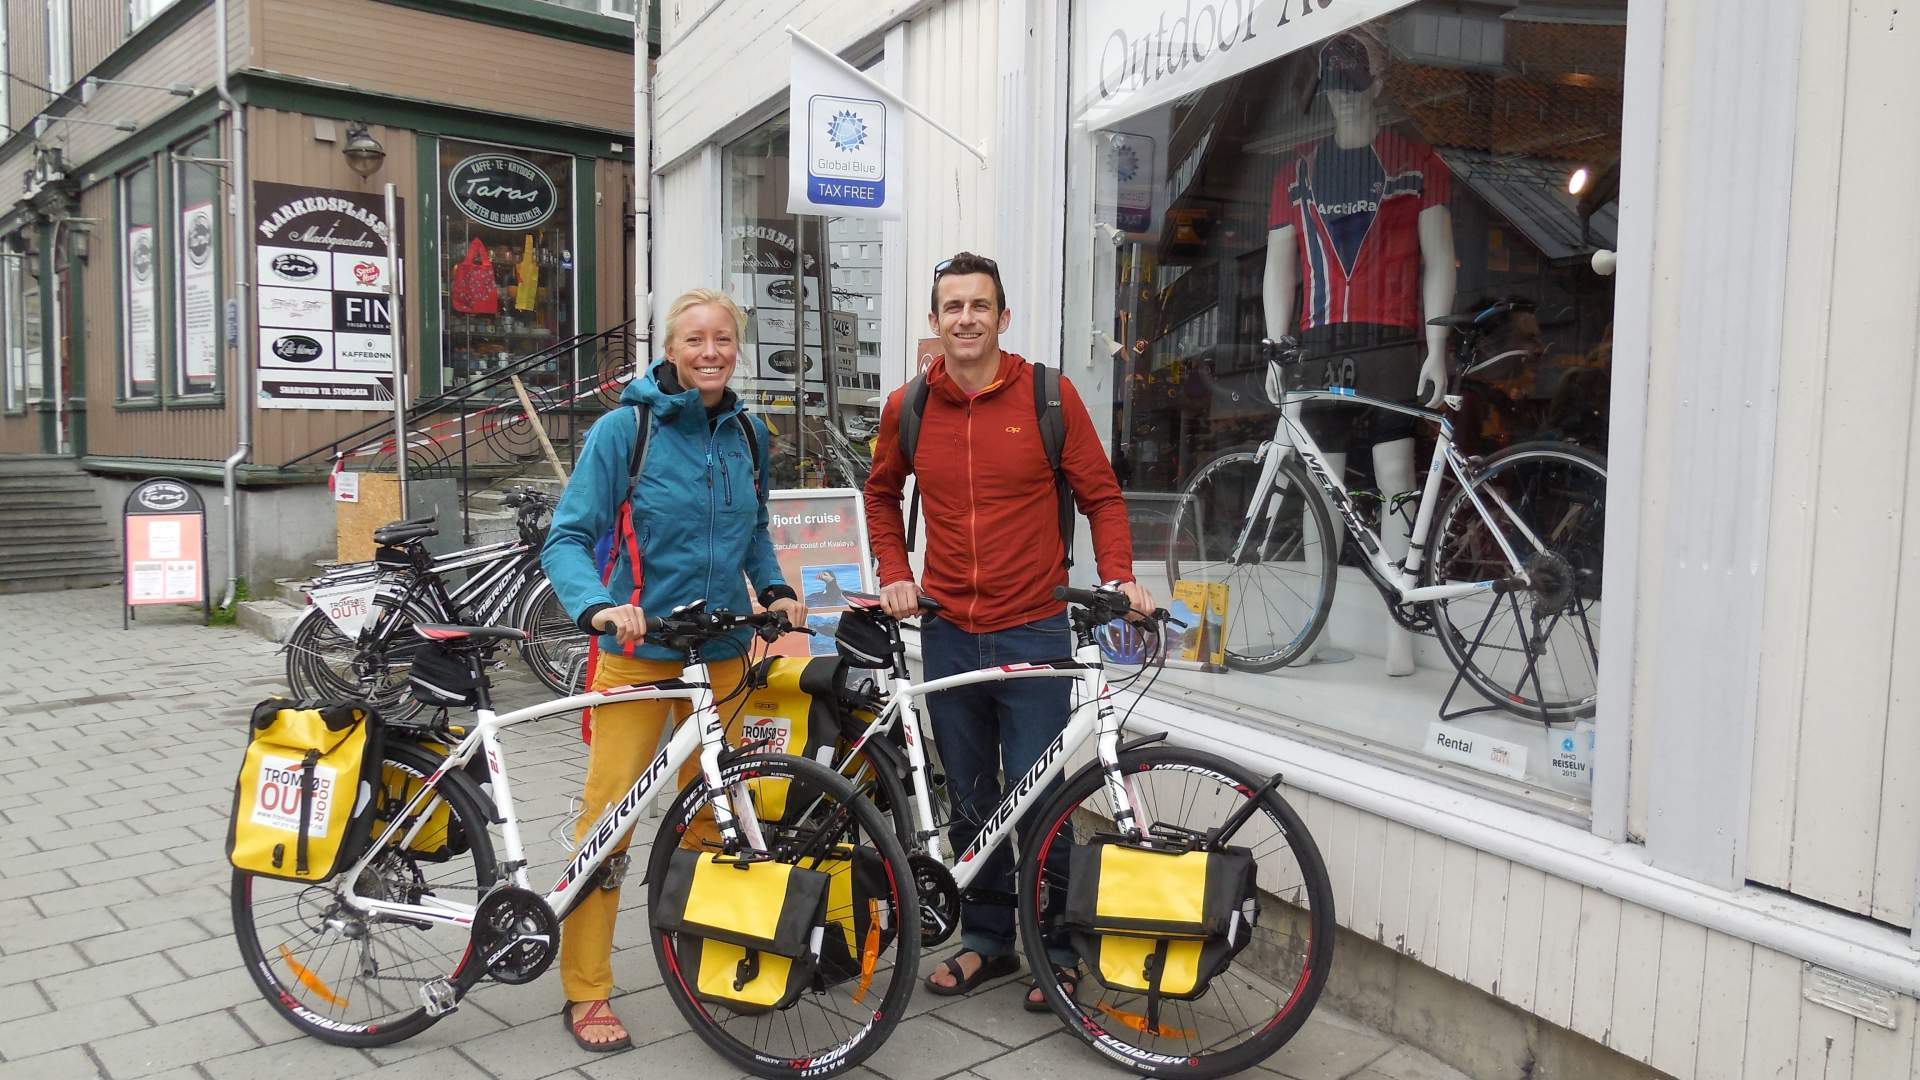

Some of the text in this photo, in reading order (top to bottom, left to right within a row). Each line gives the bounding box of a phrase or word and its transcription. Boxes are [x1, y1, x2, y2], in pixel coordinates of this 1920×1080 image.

[470, 160, 536, 181] KAFFE TE KRYDDER
[817, 158, 876, 174] Global Blue
[466, 177, 539, 202] Taras
[818, 183, 875, 200] TAX FREE
[465, 198, 489, 218] DUFTER
[500, 206, 543, 224] GAVEARTIKLER
[1318, 200, 1377, 215] ArcticRa
[259, 196, 389, 247] MARKEDSPLASS
[341, 351, 392, 359] KAFFEBØNN
[772, 512, 841, 528] fjord cruise
[331, 604, 360, 620] OUT
[1437, 733, 1473, 754] Rental
[1152, 763, 1241, 787] MERIDA
[1552, 759, 1586, 771] REISELIV
[264, 768, 320, 791] TROMØ
[981, 731, 1065, 846] MERIDA
[314, 778, 331, 822] DOOR
[577, 744, 671, 877] MERIDA
[292, 1006, 369, 1033] MERIDA
[1098, 1034, 1188, 1065] MERIDA
[800, 1057, 846, 1077] MAXXIS
